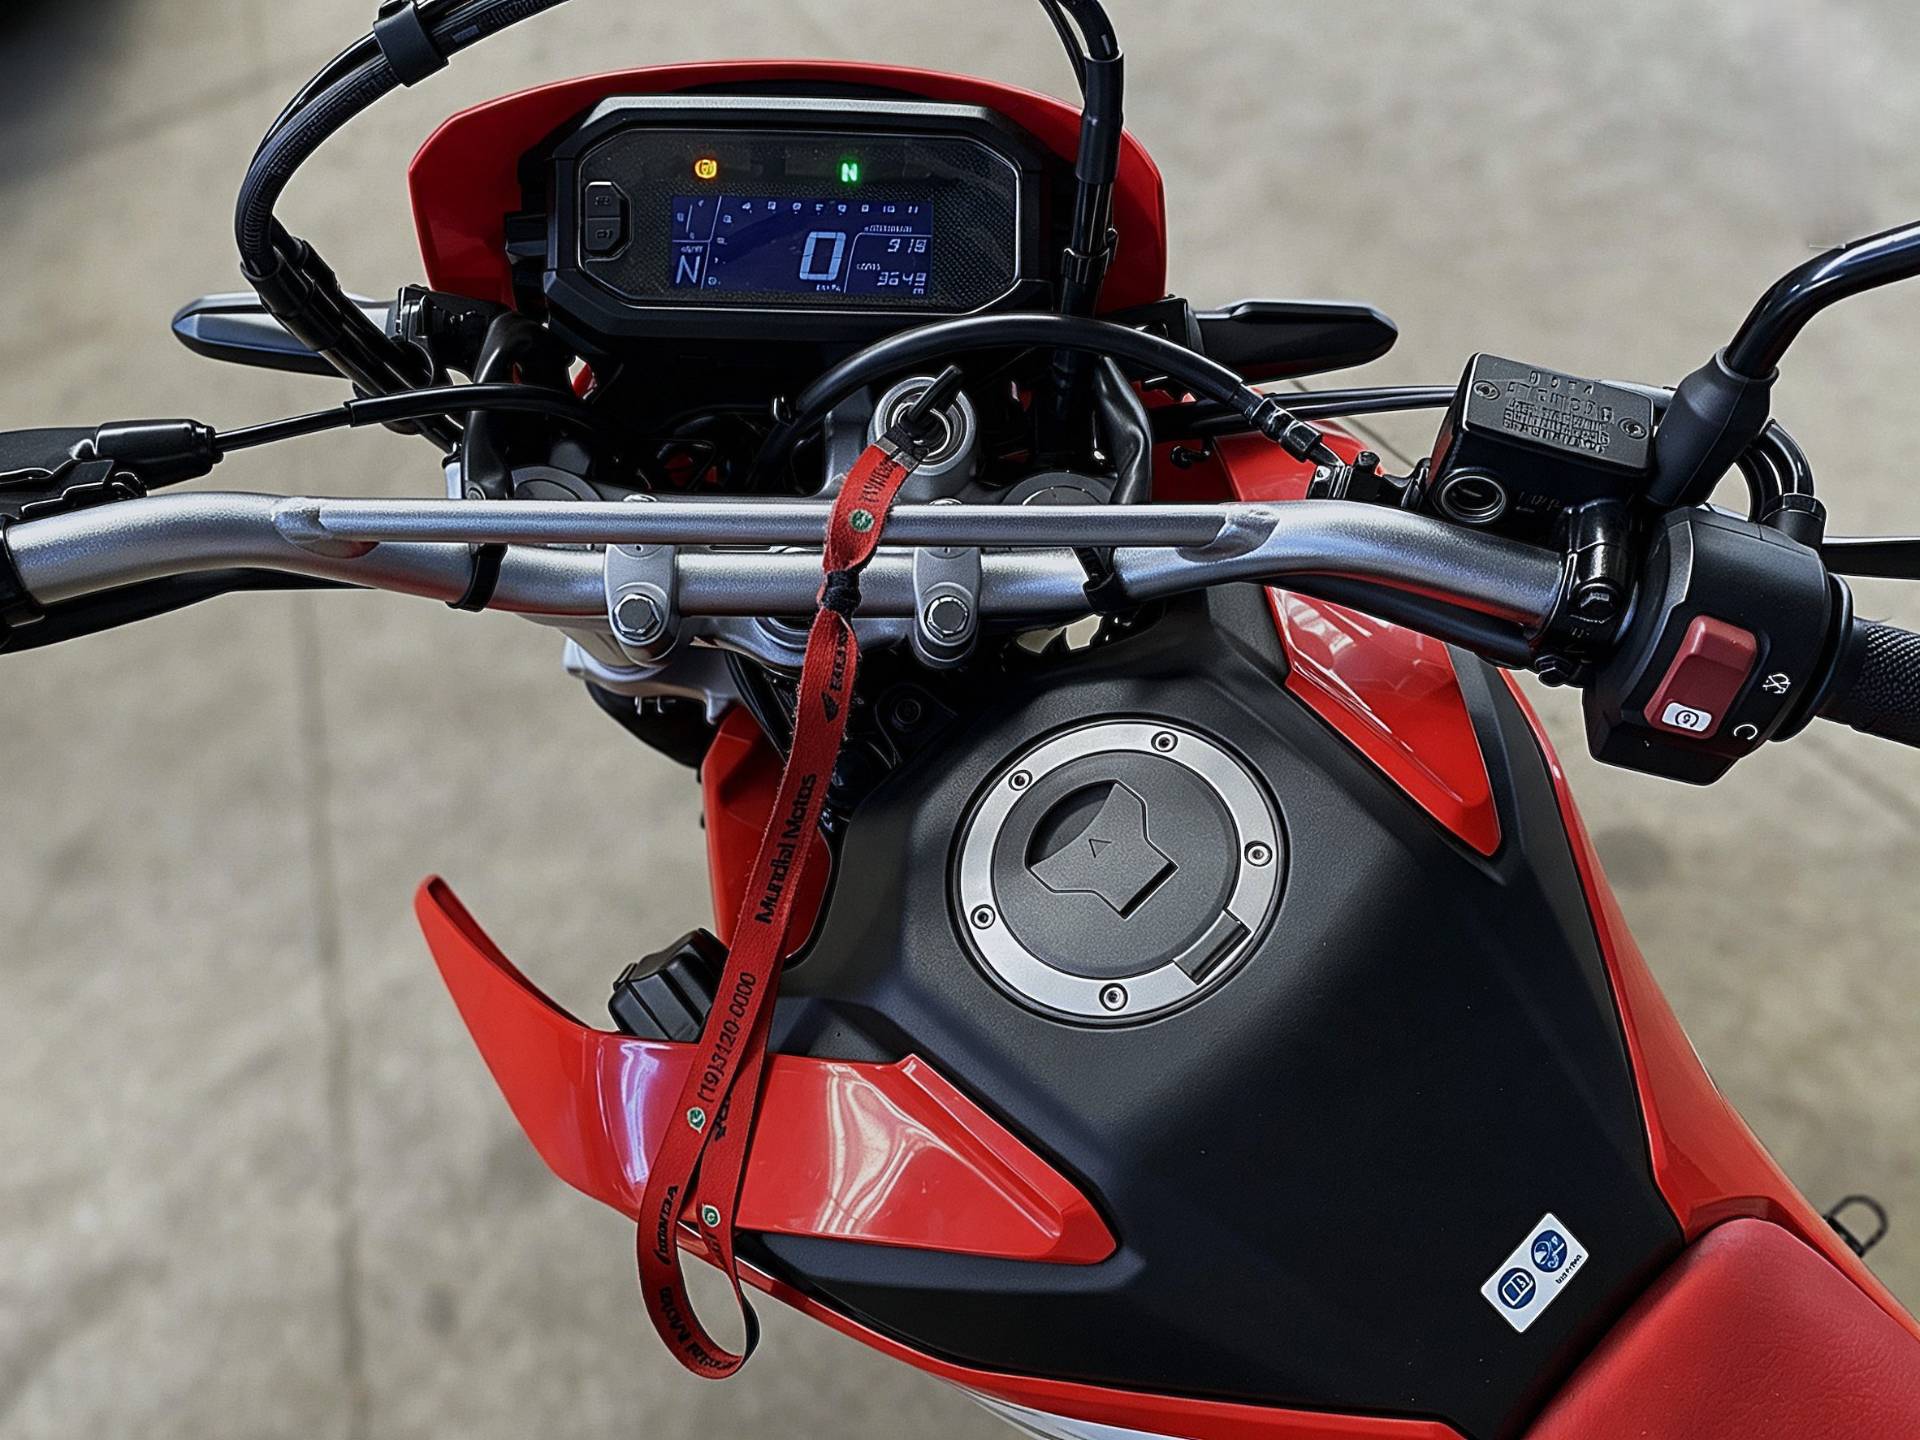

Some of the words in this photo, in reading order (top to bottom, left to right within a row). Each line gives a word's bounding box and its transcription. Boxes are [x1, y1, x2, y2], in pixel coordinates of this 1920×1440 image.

[841, 162, 858, 182] N
[676, 254, 701, 284] N
[800, 231, 846, 281] 0
[782, 773, 817, 839] Motos
